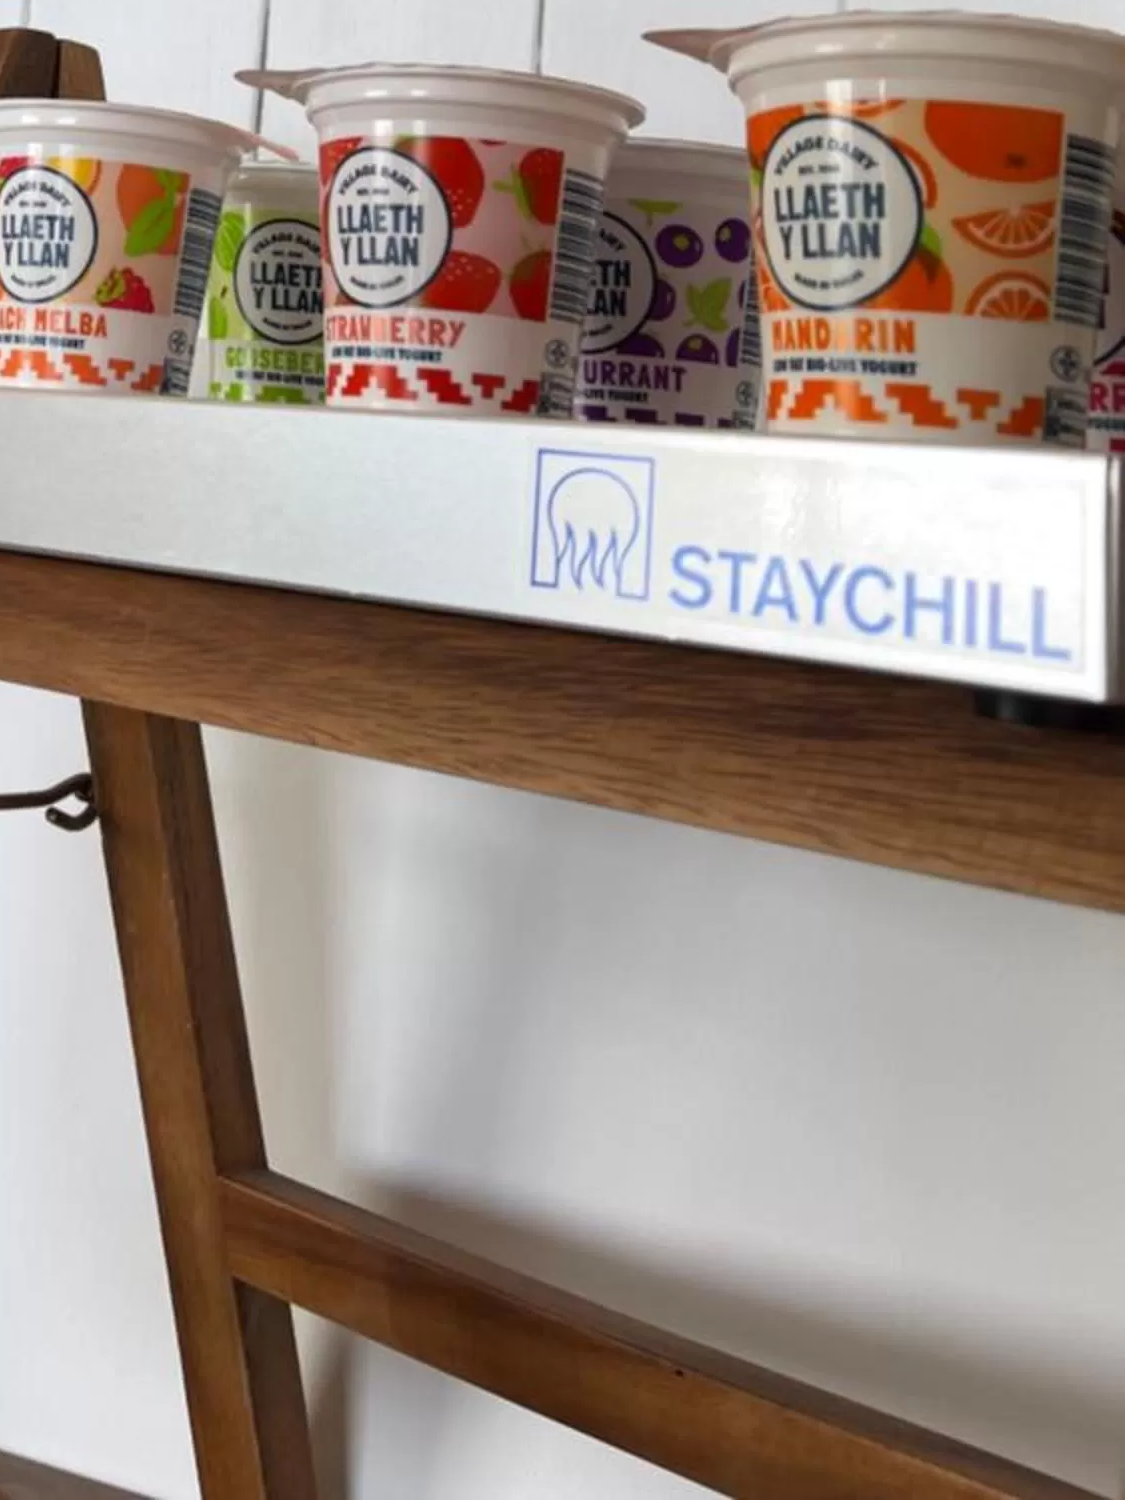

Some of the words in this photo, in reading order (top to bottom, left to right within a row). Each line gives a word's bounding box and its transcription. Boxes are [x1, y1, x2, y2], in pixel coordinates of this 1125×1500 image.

[337, 203, 424, 235] LLAETH
[773, 182, 886, 223] LLAETH
[1, 213, 75, 242] LLAETH
[779, 224, 793, 261] Y
[801, 221, 881, 260] LLAN
[4, 242, 13, 267] Y
[17, 241, 70, 269] LLAN
[340, 236, 352, 267] Y
[357, 235, 420, 268] LLAN
[253, 286, 264, 310] Y
[271, 286, 325, 314] LLAN
[34, 307, 108, 338] MELBA
[325, 314, 468, 349] TRAWERRY
[771, 316, 916, 354] MANDRIN
[583, 359, 688, 393] URRANT
[668, 544, 1072, 661] STAYCHILL
